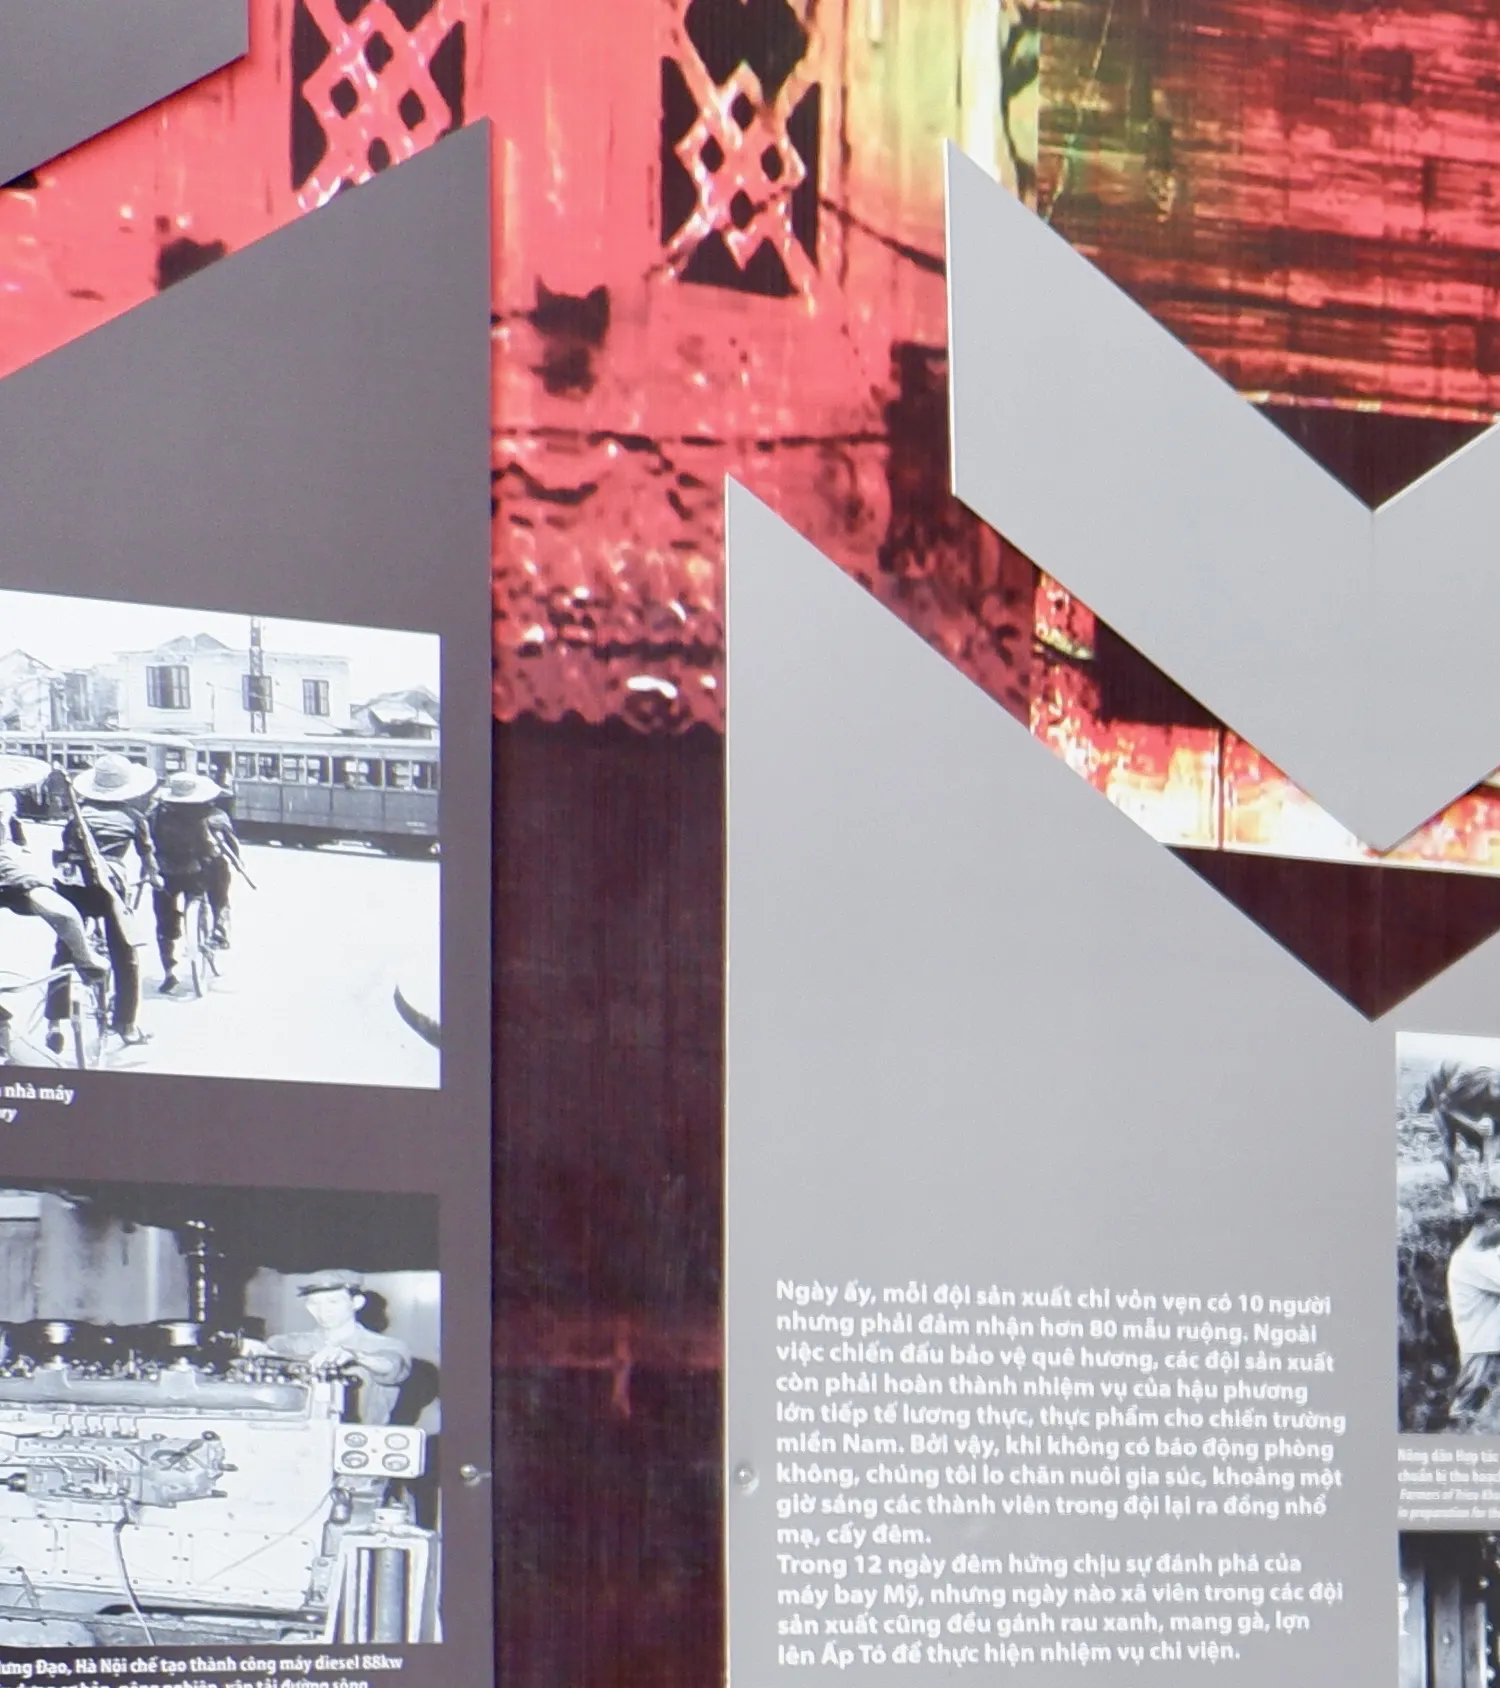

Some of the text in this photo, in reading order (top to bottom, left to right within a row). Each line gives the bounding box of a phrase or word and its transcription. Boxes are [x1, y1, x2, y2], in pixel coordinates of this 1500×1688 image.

[4, 1082, 75, 1105] nhà máy
[776, 1279, 1330, 1317] Ngày ấy, mỗi đội sản xuất chỉ vỏn vẹn có 10 người
[776, 1309, 1316, 1346] nhưng phải đảm nhận hơn 80 mẫu ruộng. Ngoài
[775, 1339, 1333, 1373] việc chiến đấu bảo vệ quê hương, các đội sản xuất
[0, 1661, 32, 1678] ưng
[314, 1654, 359, 1670] diesel
[361, 1653, 402, 1669] 88kw
